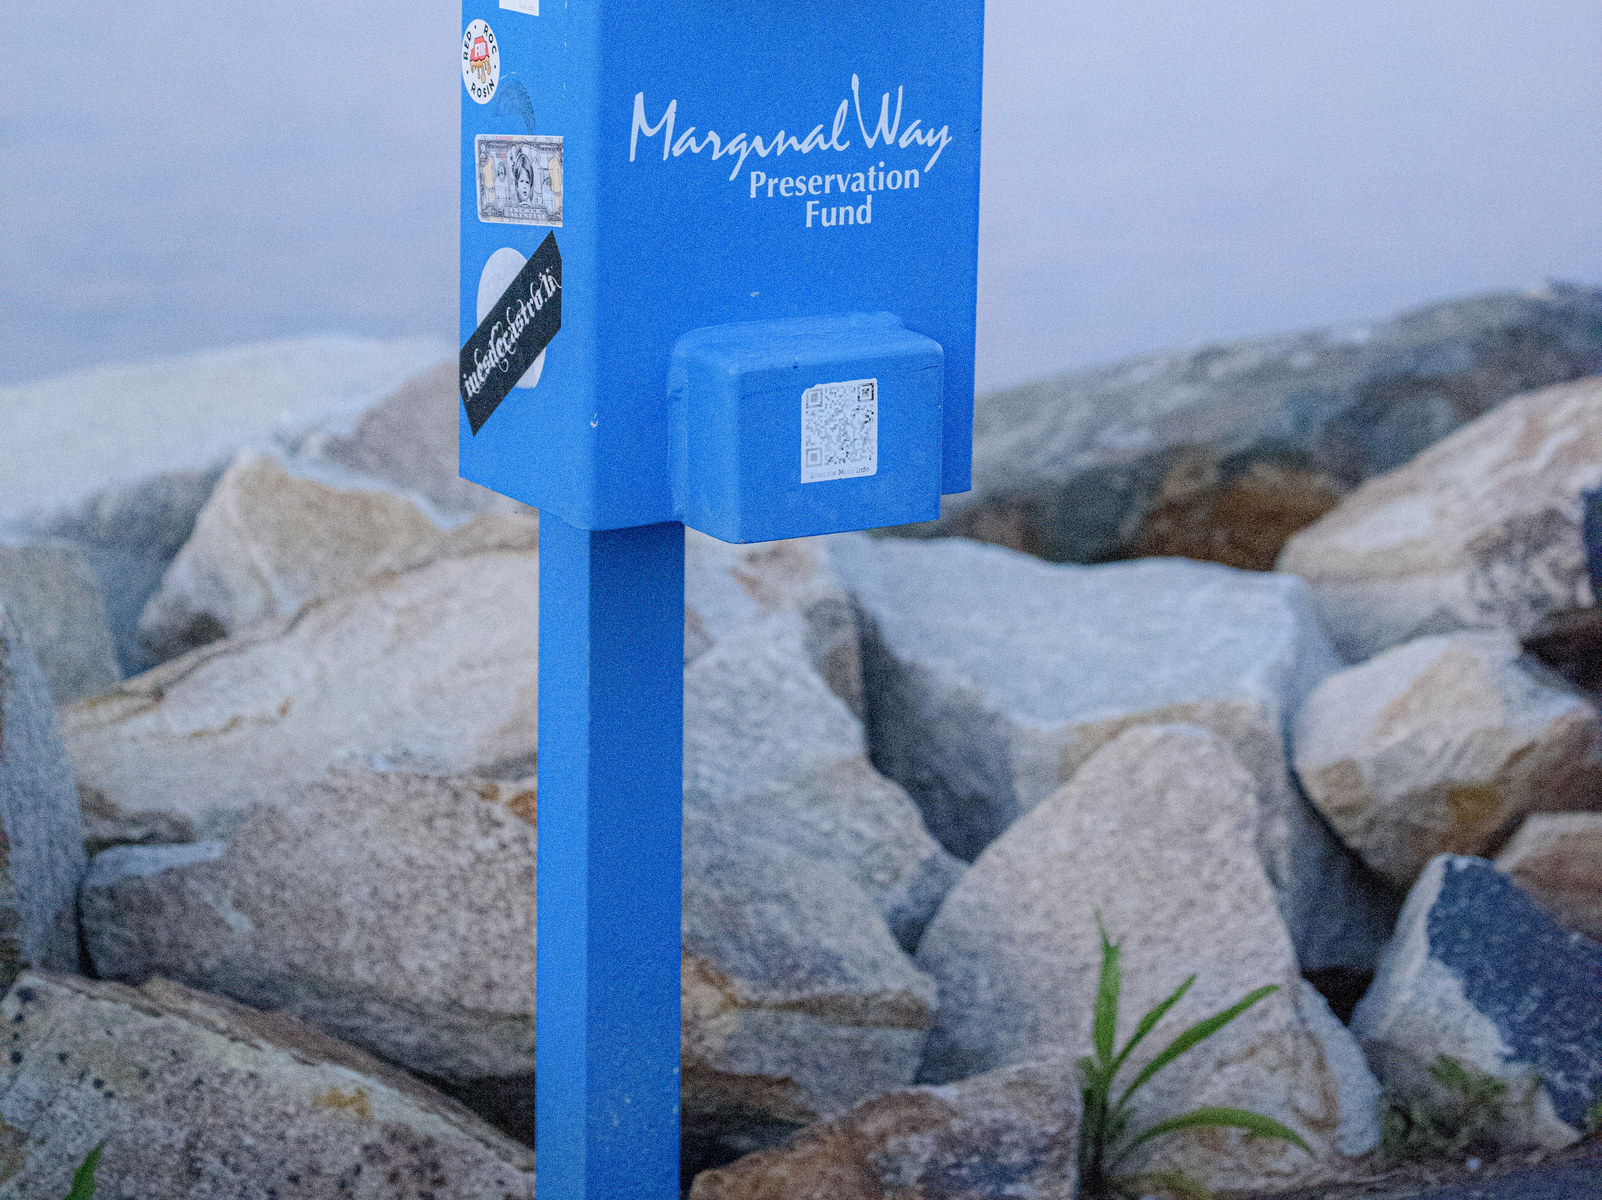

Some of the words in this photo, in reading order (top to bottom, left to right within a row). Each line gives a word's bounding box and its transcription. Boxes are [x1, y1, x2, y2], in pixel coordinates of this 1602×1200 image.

[463, 31, 472, 61] RED
[471, 79, 495, 98] ROSIN
[629, 91, 850, 181] Marginal
[852, 73, 952, 173] Way
[750, 161, 920, 198] Preservation
[806, 195, 872, 228] Fund
